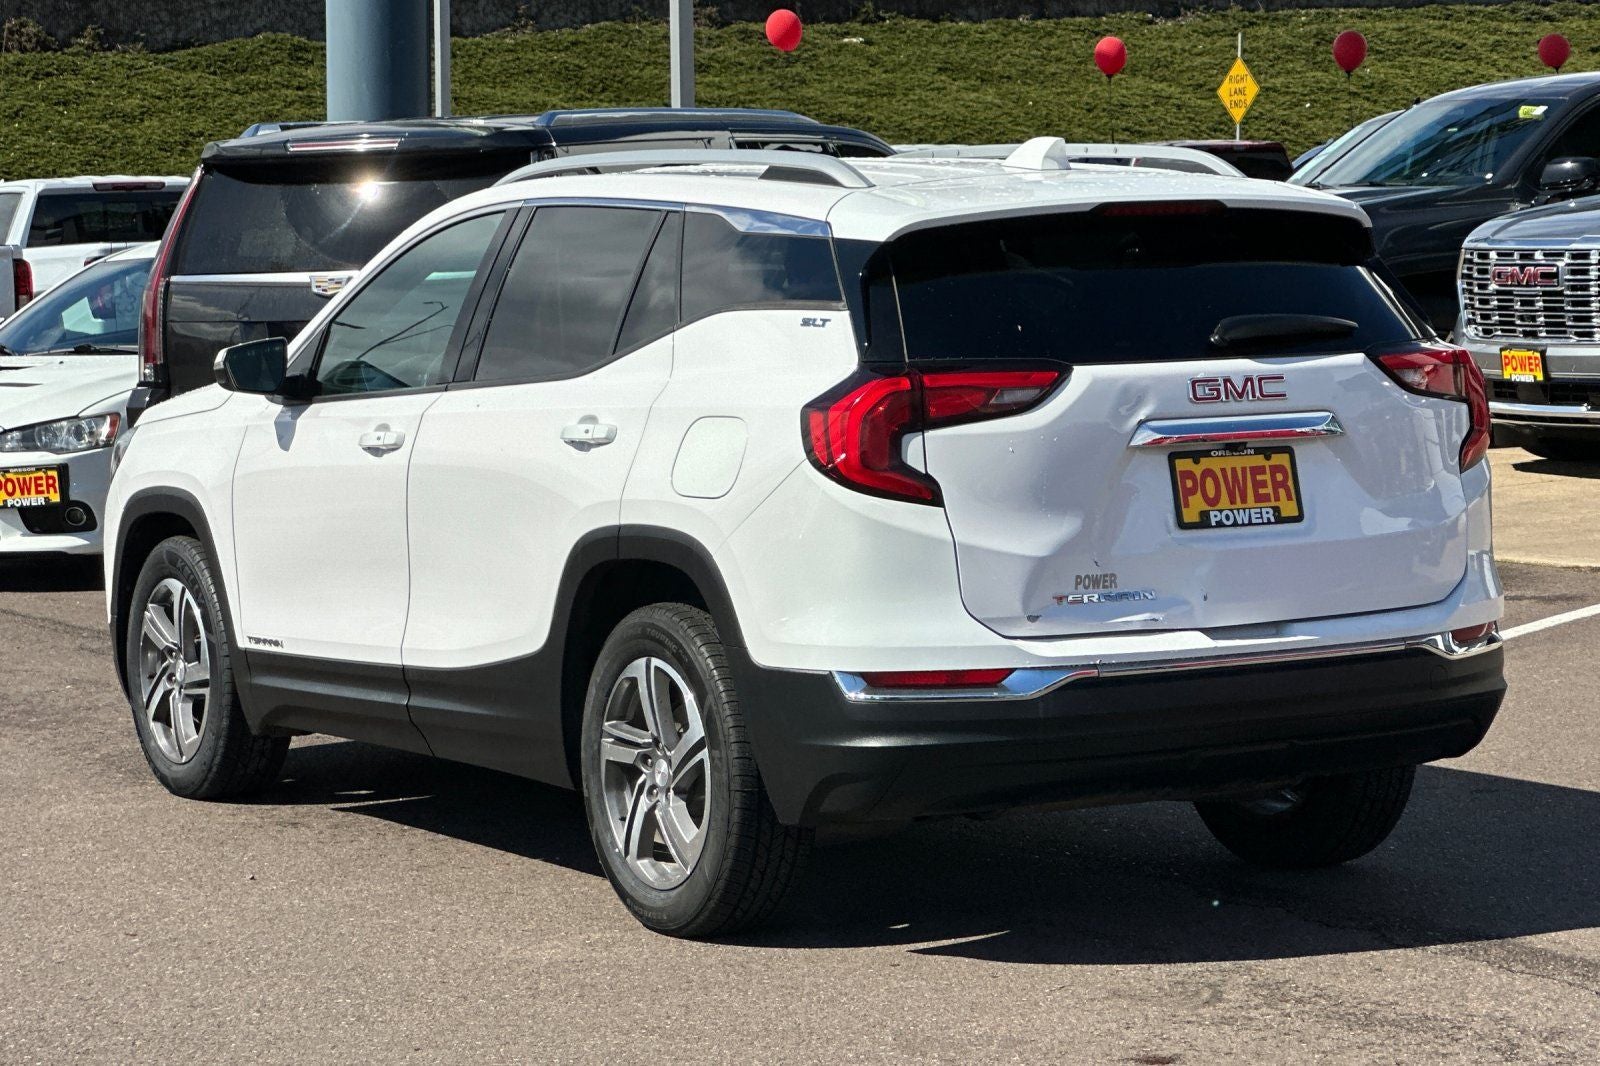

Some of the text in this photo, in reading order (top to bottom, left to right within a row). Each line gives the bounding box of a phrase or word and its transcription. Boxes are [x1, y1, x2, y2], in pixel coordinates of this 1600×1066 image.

[1228, 73, 1249, 84] RIGHT
[1229, 87, 1247, 97] LANE
[1229, 99, 1248, 109] ENDS
[1490, 265, 1556, 286] GMC
[800, 317, 832, 328] SLT
[1503, 354, 1542, 373] POWER
[1511, 373, 1535, 383] POWER
[1189, 374, 1287, 403] GMC
[1178, 464, 1294, 509] POWER
[7, 497, 45, 507] POWER
[1209, 507, 1276, 527] POWER
[1074, 573, 1118, 591] POWER
[1052, 589, 1158, 606] TERRAIN
